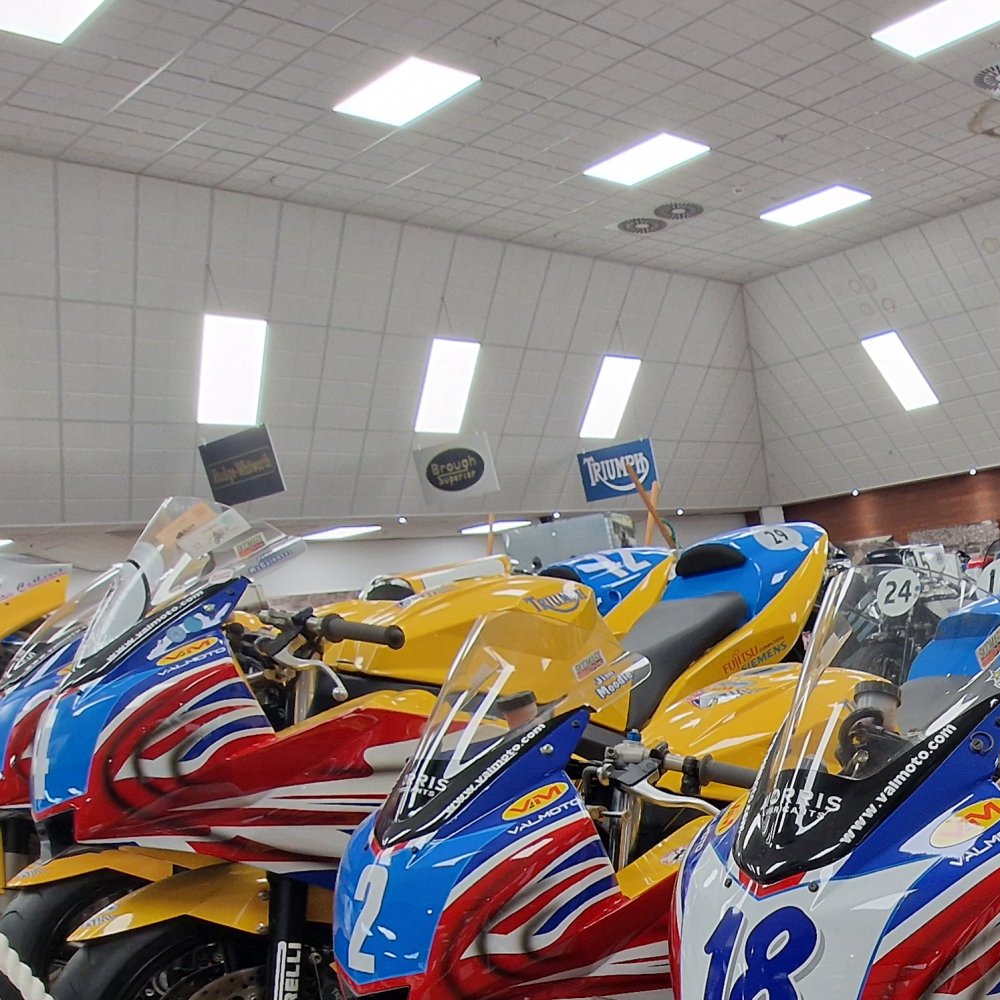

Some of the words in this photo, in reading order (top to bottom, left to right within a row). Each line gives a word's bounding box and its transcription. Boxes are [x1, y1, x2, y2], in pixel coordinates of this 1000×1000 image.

[430, 456, 477, 476] Brough
[583, 452, 649, 487] TRIUMPH
[763, 528, 787, 545] 29
[884, 579, 913, 605] 24
[157, 647, 227, 676] VALMOTO
[723, 645, 760, 675] FUJITSU
[741, 641, 788, 672] SIEMENS
[596, 671, 635, 699] Moodie
[444, 723, 547, 819] www.valmoto.com
[839, 723, 958, 845] www.valmoto.com
[507, 798, 580, 836] VALMOTO
[347, 863, 390, 974] 2
